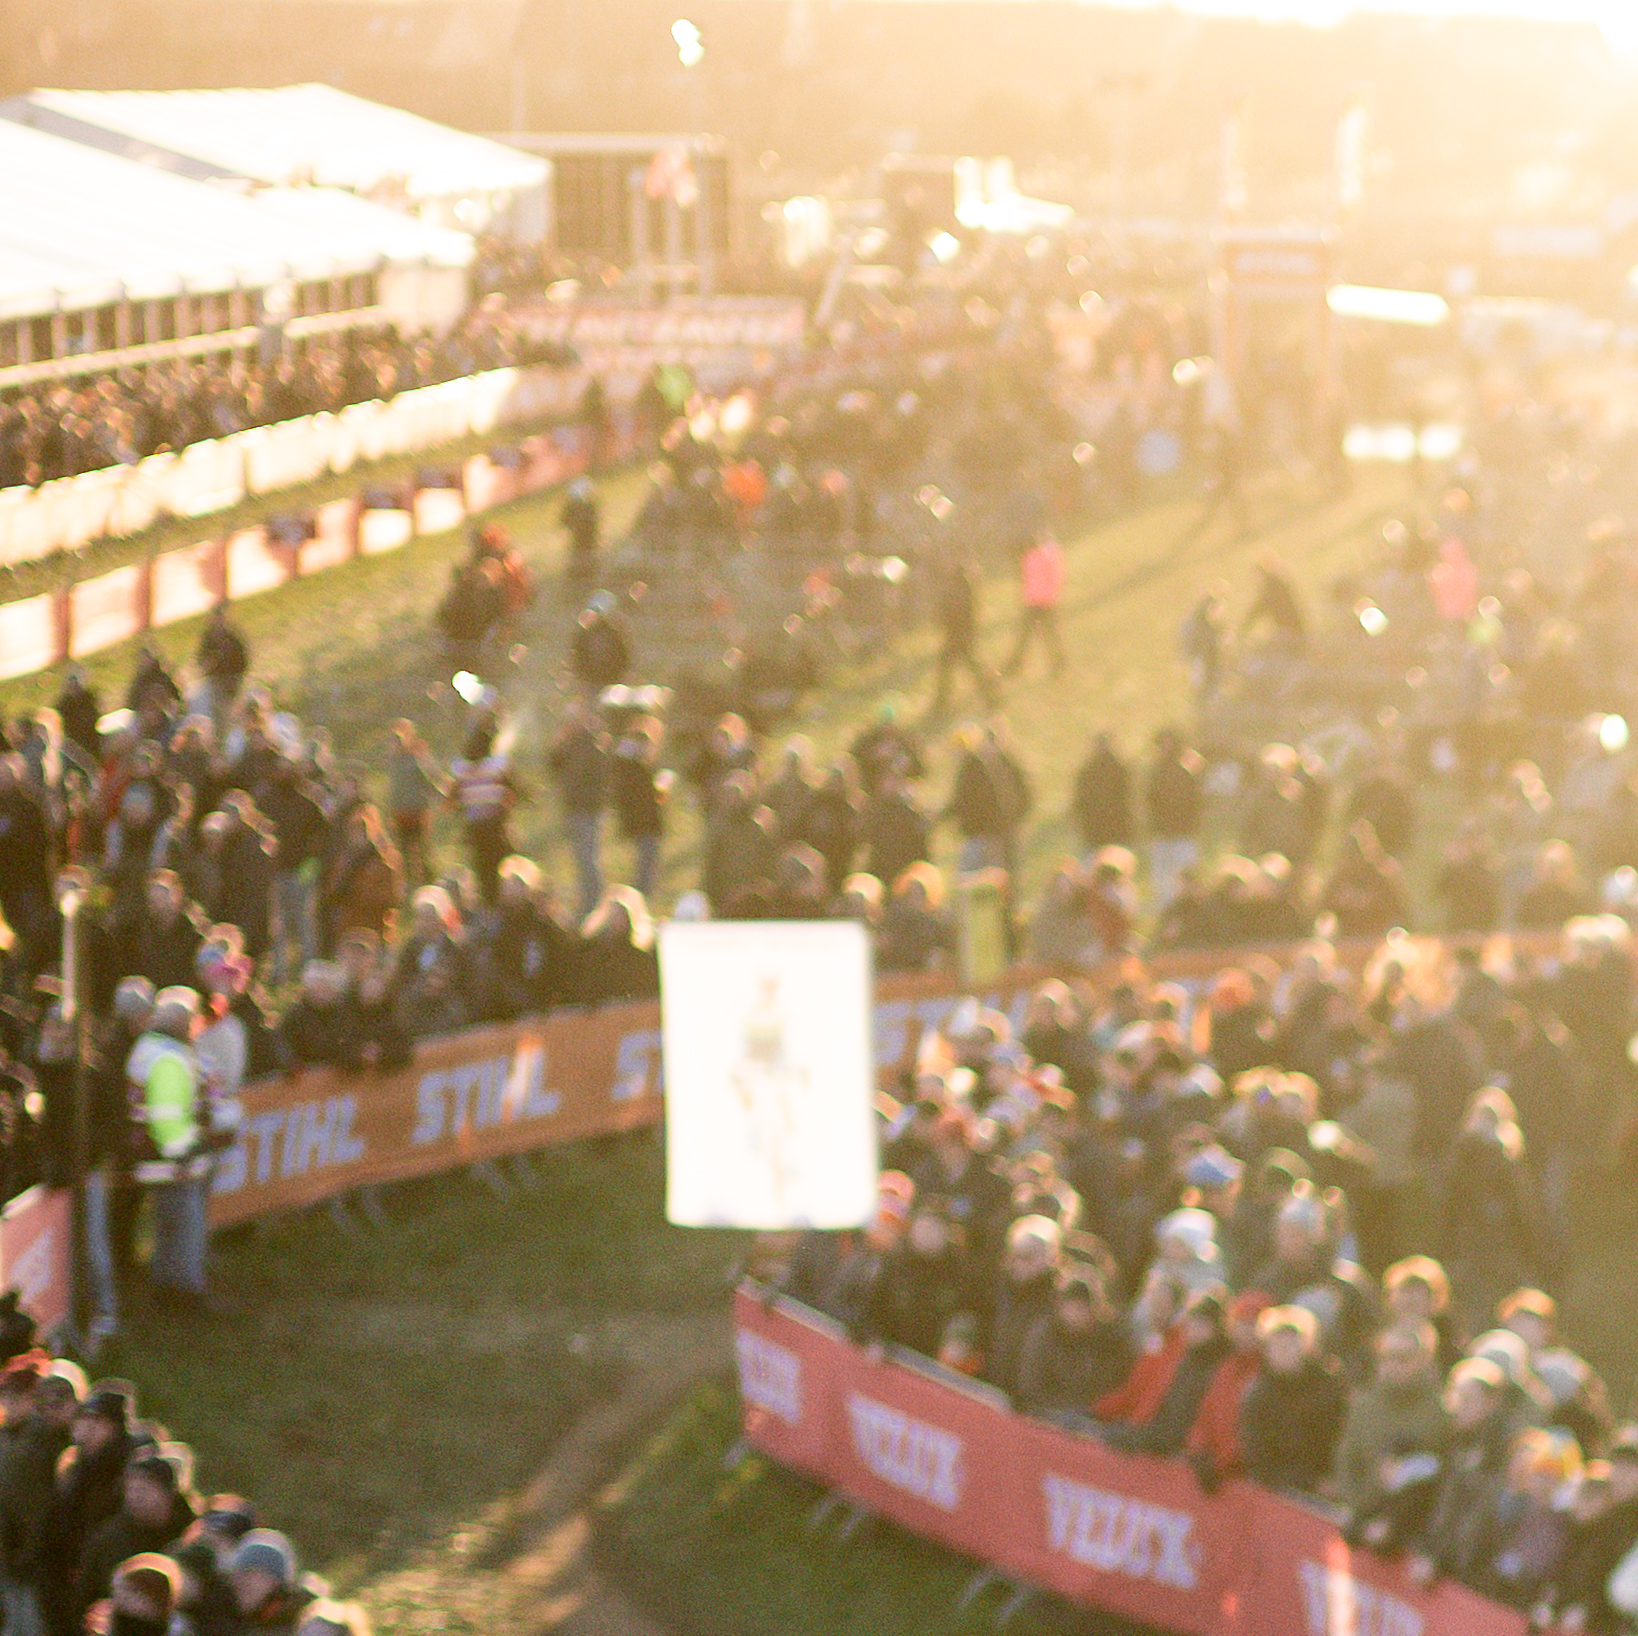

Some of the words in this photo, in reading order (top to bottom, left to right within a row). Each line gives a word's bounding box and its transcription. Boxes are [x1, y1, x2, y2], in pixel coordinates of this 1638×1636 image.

[411, 1034, 560, 1146] STIHL
[846, 1395, 964, 1510] VELUX
[1043, 1472, 1197, 1591] VELUX
